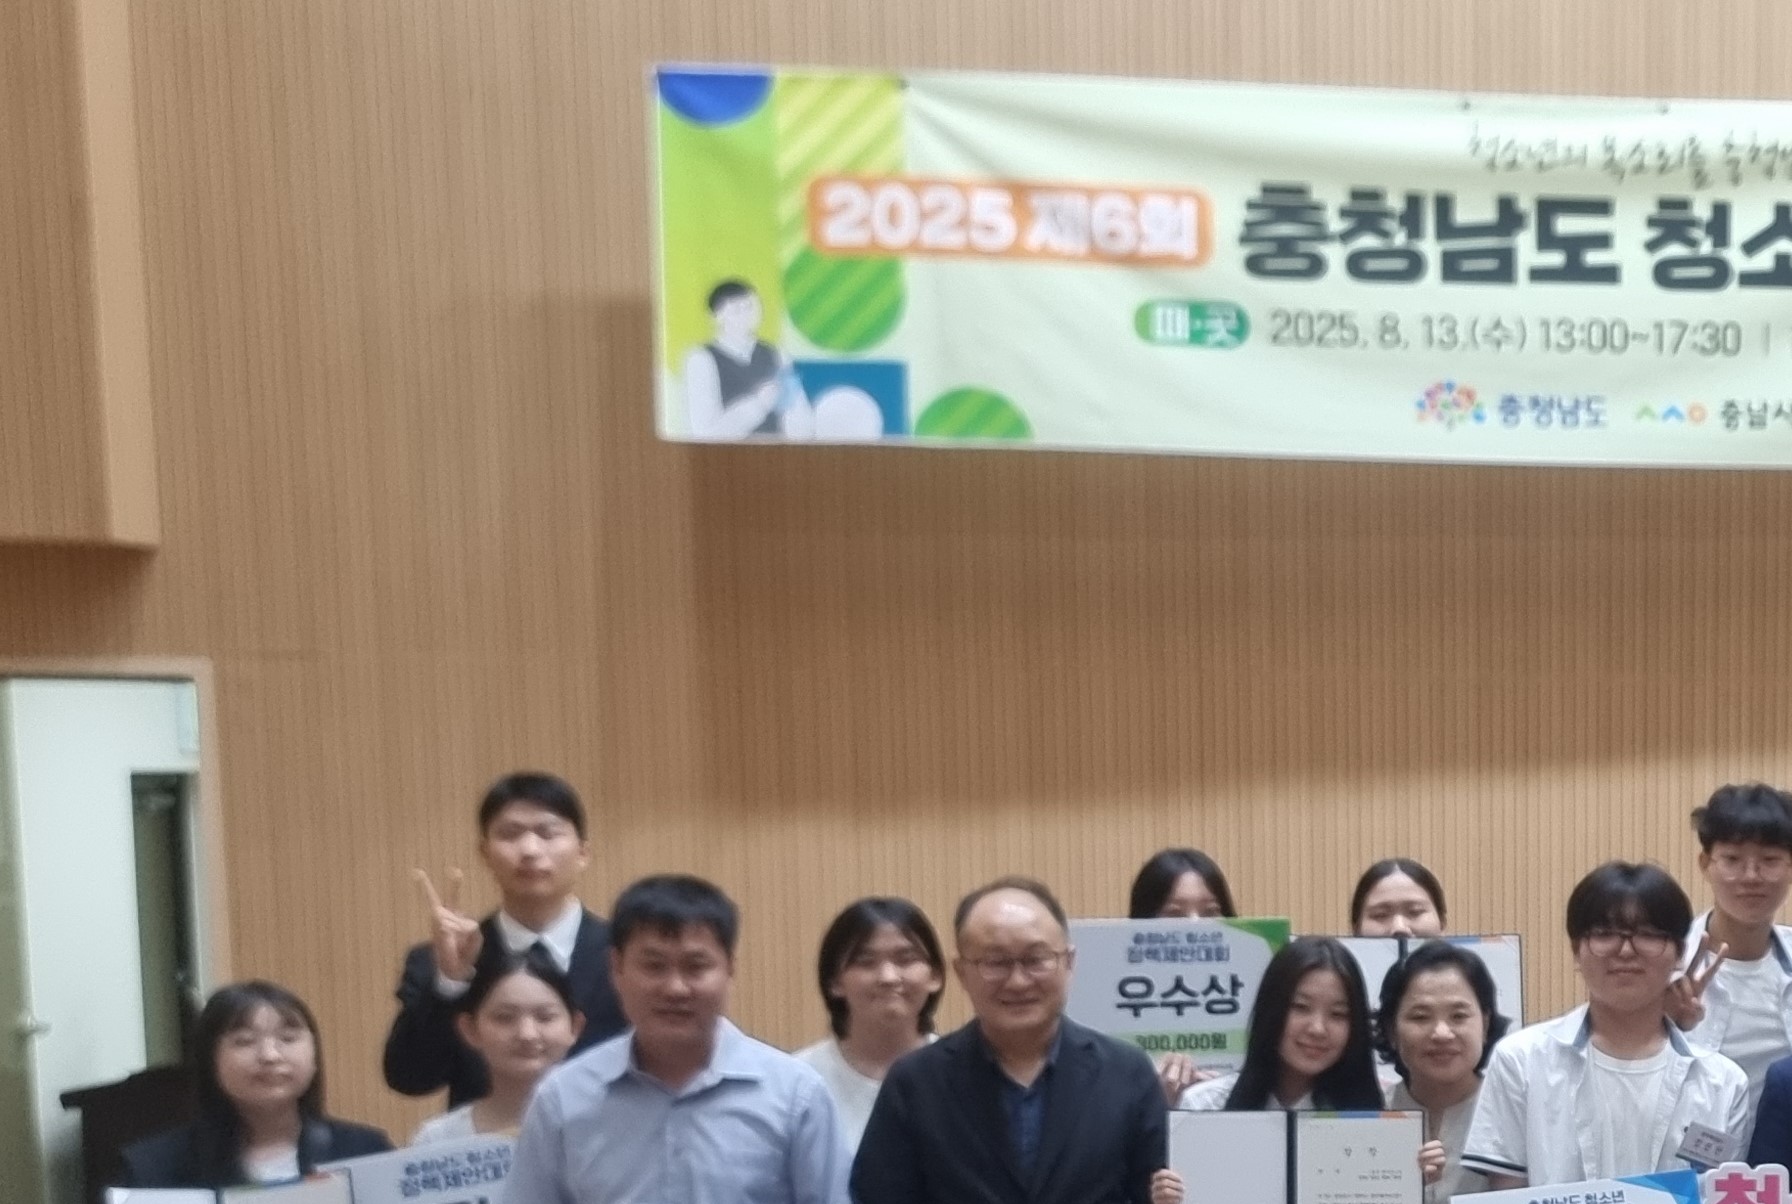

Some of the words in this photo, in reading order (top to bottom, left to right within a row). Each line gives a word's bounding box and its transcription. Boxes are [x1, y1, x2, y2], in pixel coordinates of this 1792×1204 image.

[822, 183, 1018, 250] 2025
[1239, 181, 1621, 286] 충청남도
[1539, 316, 1742, 357] 13:00~17:30
[1500, 394, 1606, 429] 충청남도
[1116, 973, 1244, 1017] 우수상
